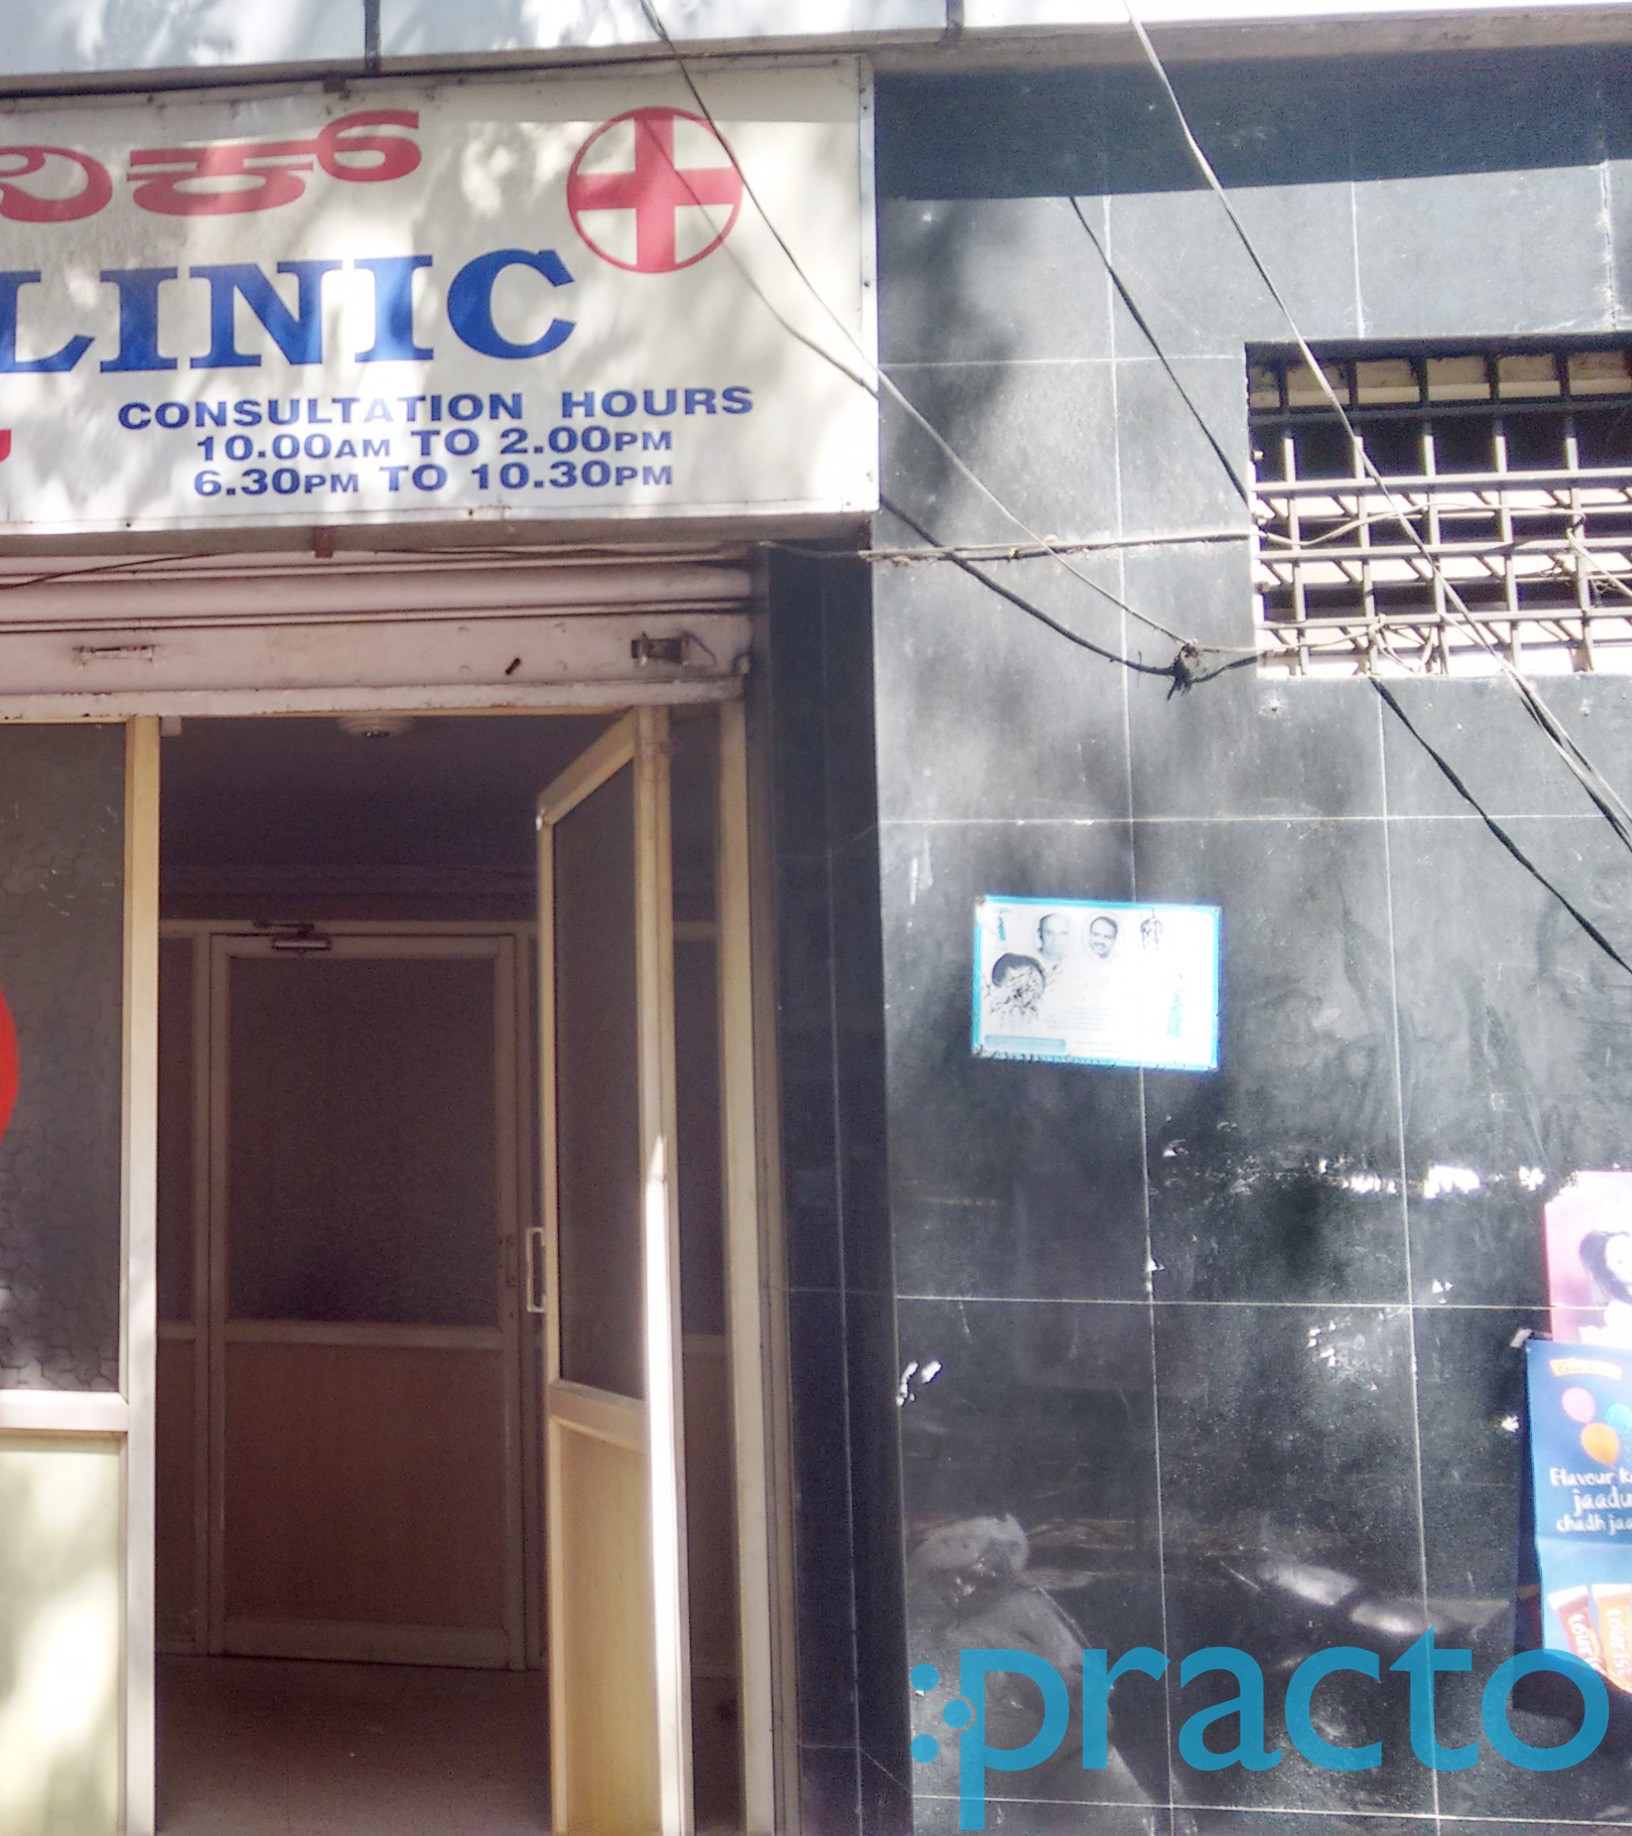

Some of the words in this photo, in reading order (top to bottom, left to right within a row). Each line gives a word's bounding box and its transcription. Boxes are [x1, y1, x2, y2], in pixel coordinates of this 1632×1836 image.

[118, 393, 523, 429] CONSULTATION
[561, 386, 754, 418] HOURS
[196, 433, 391, 461] 10.00AM
[411, 428, 479, 456] TO
[500, 425, 673, 454] 2.00PM
[193, 468, 359, 496] 6.30PM
[379, 464, 448, 492] TO
[471, 459, 673, 489] 10.30PM
[1549, 1467, 1616, 1487] Flavour
